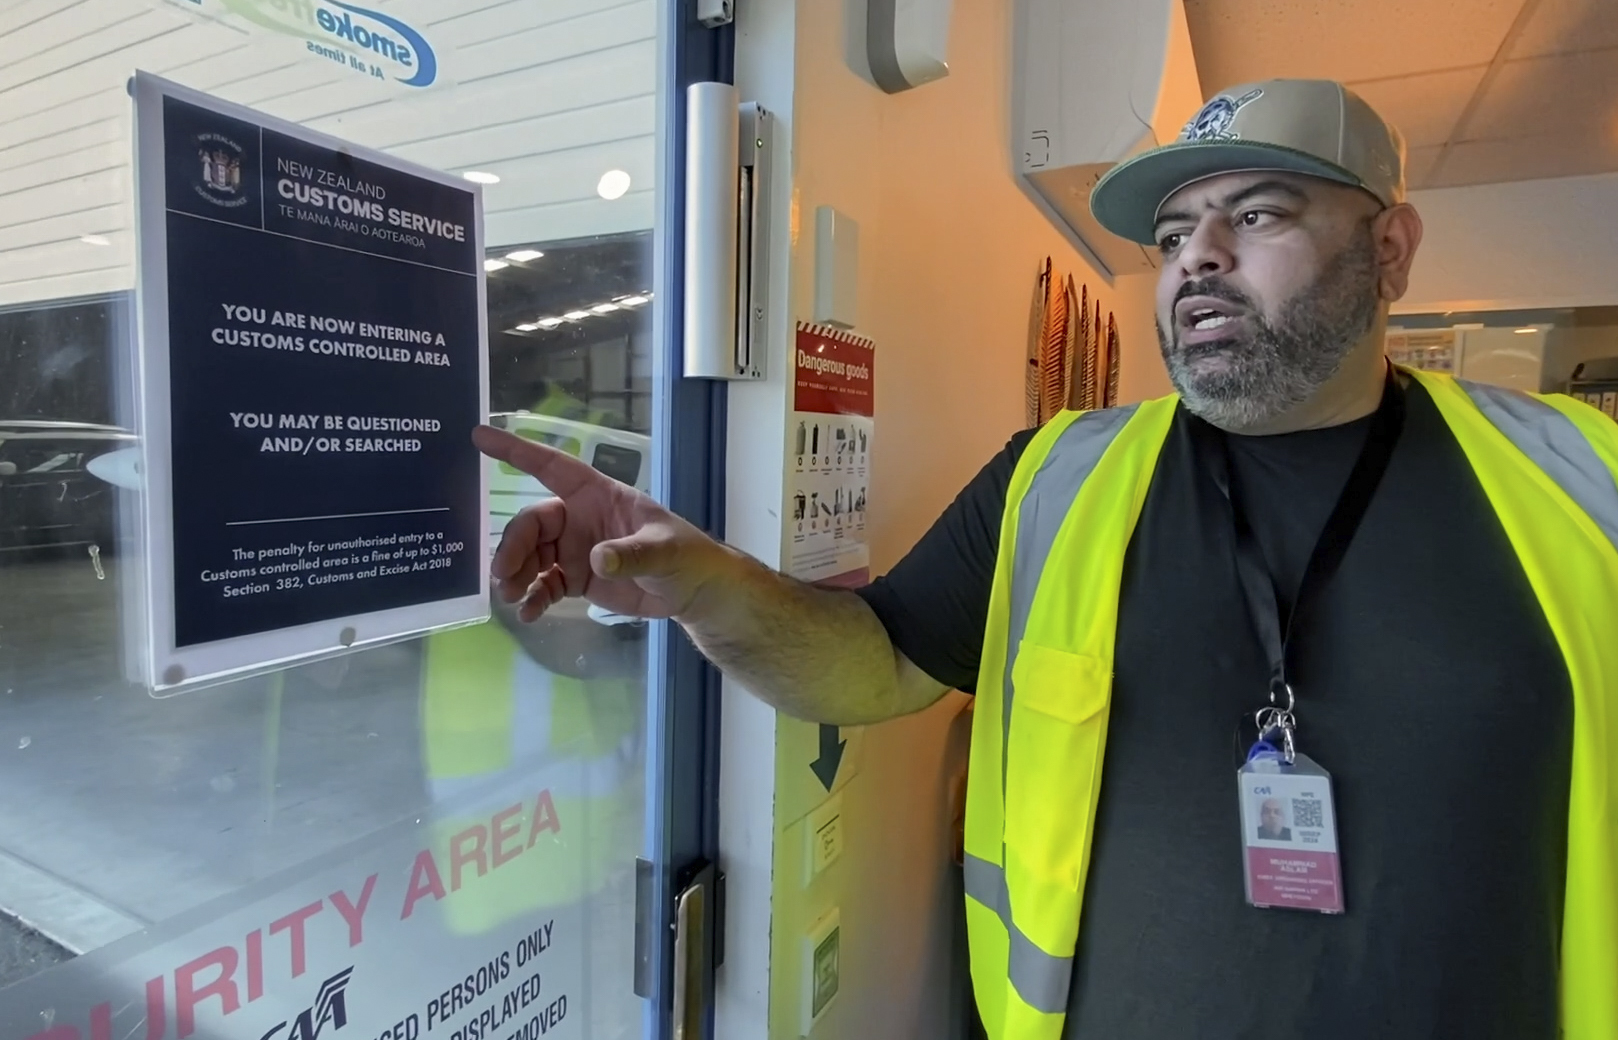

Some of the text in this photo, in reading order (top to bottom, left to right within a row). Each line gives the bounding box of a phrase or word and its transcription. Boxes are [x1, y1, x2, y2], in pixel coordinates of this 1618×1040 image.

[277, 157, 386, 200] NEW ZEALAND
[278, 179, 465, 242] CUSTOMS SERVICE
[278, 204, 293, 218] TE
[297, 209, 331, 227] MANA
[361, 224, 370, 236] O
[371, 227, 426, 249] AOTEAROA
[222, 303, 446, 346] YOU ARE NOW ENTERING A
[211, 328, 450, 367] CUSTOMS CONTROLLED AREA
[798, 349, 869, 381] Dangerous goods
[230, 412, 441, 432] YOU MAY BE QUESTIONED
[260, 436, 421, 456] AND/OR SEARCHED
[201, 541, 464, 582] Customs controlled area is a fine of up to $1,000
[232, 547, 255, 560] The
[258, 543, 305, 561] penalty
[308, 541, 325, 553] for
[327, 533, 396, 551] unauthorised
[398, 533, 424, 544] entry
[425, 532, 435, 540] to
[223, 558, 451, 597] Section 382, Customs and Excise Act 2018
[22, 788, 561, 1040] URITY AREA
[427, 951, 510, 1031] PERSONS
[516, 919, 554, 967] ONLY
